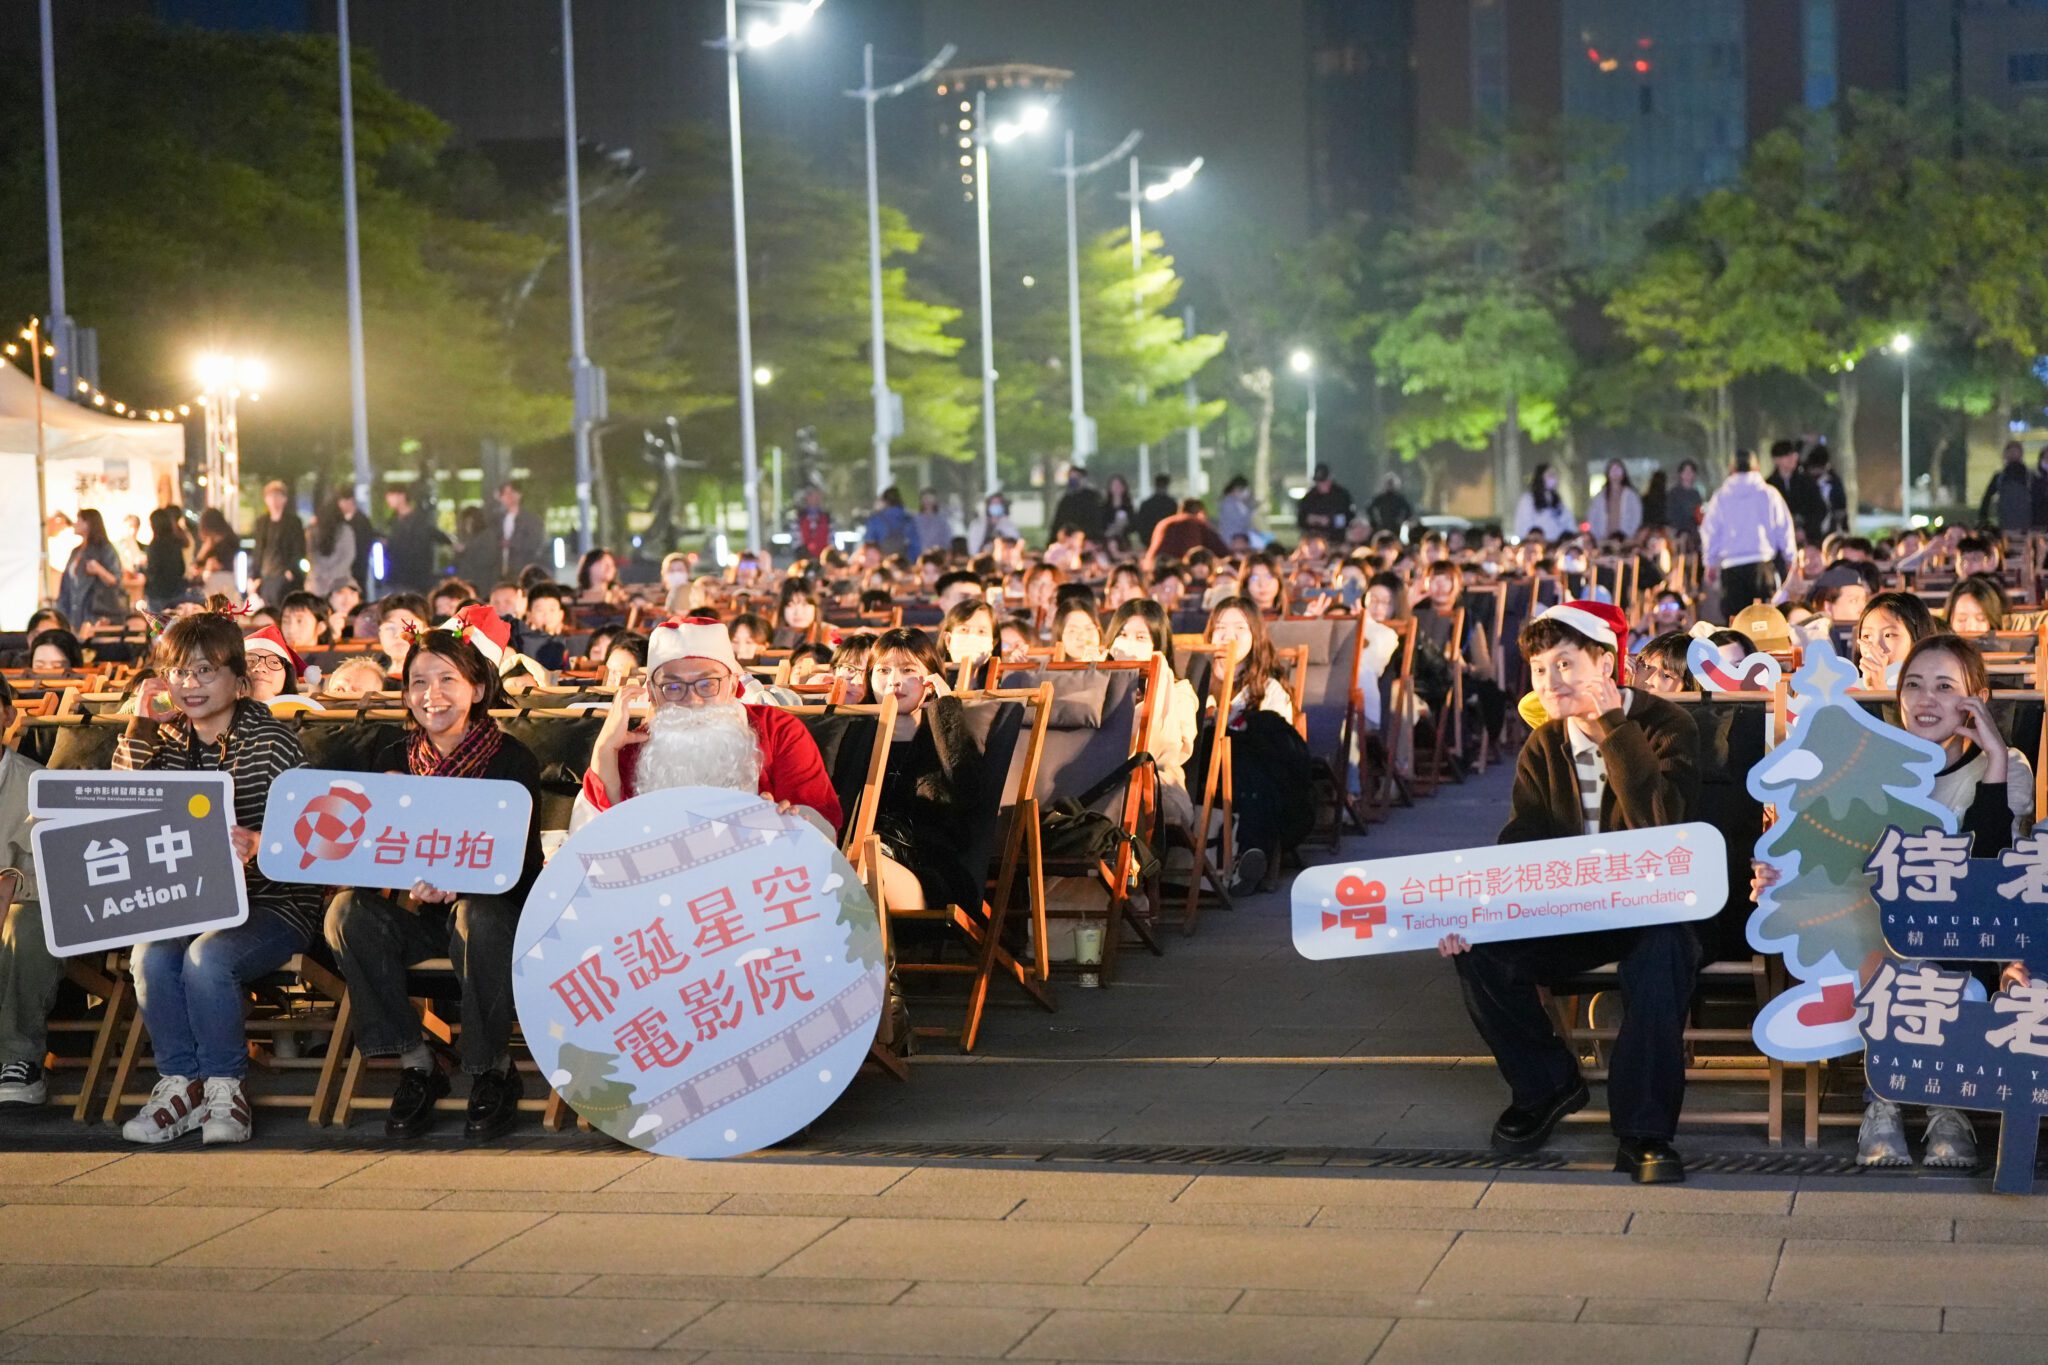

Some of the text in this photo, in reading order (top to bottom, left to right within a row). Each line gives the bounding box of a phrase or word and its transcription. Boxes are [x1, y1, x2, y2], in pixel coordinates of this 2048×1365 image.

[83, 825, 192, 886] 台中
[374, 826, 495, 869] 台中拍
[1399, 845, 1694, 905] 台中市影視發展基金會
[1402, 913, 1467, 930] Taichung
[1472, 906, 1503, 923] Film
[1507, 898, 1607, 919] Development
[1888, 914, 2018, 926] SAMURAI
[549, 866, 820, 1028] 耶誕星空
[1907, 930, 2031, 948] 精品和牛
[613, 946, 814, 1072] 電影院
[1873, 1055, 2003, 1077] SAMURAI
